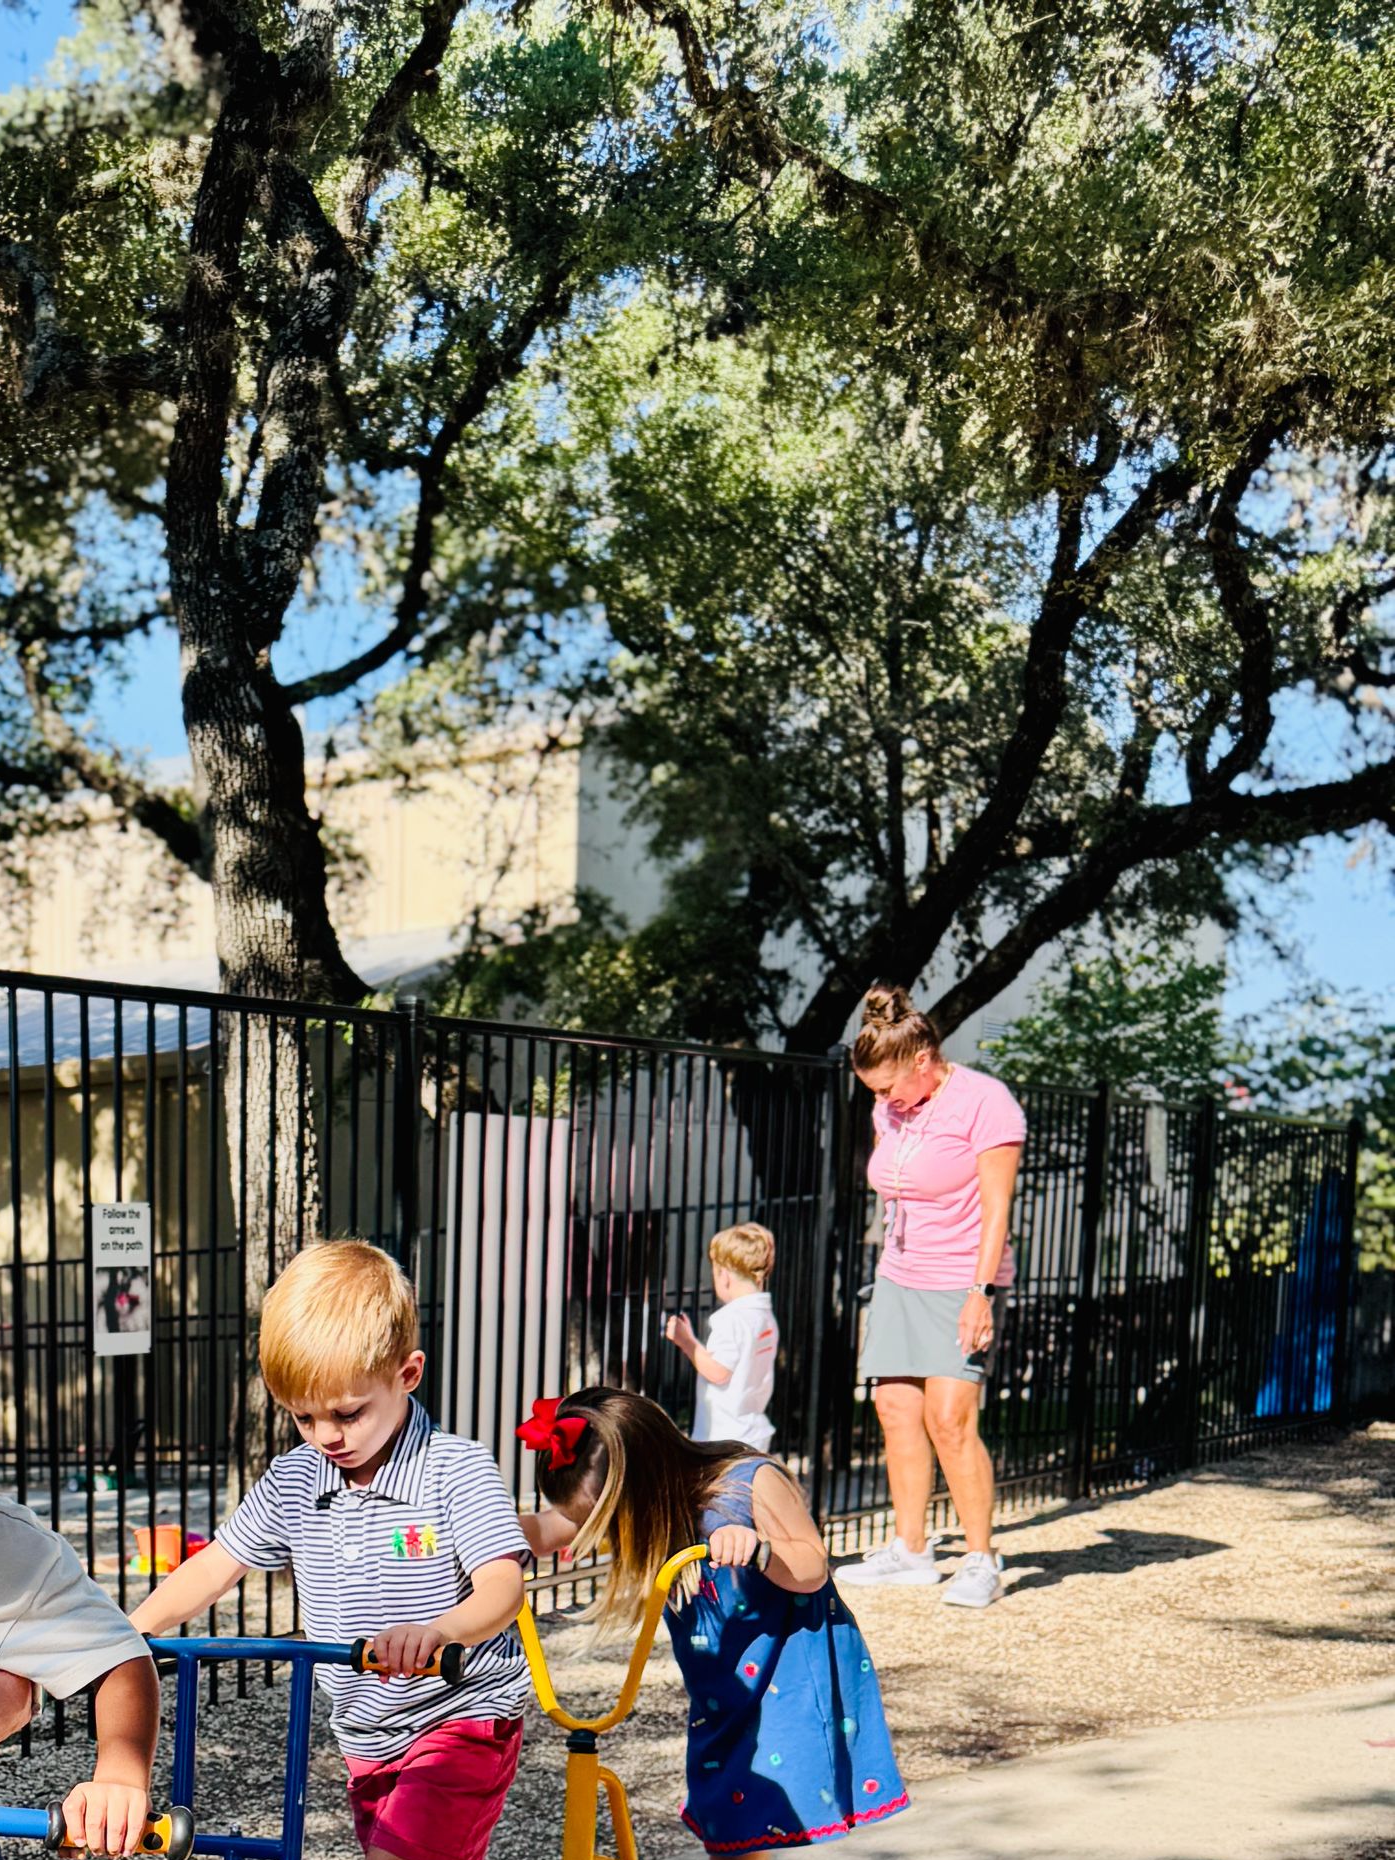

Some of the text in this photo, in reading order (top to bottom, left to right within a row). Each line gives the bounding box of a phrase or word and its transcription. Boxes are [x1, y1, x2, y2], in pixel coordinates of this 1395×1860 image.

[102, 1208, 141, 1220] Follow the
[109, 1226, 136, 1236] arrows
[100, 1241, 144, 1255] on the path
